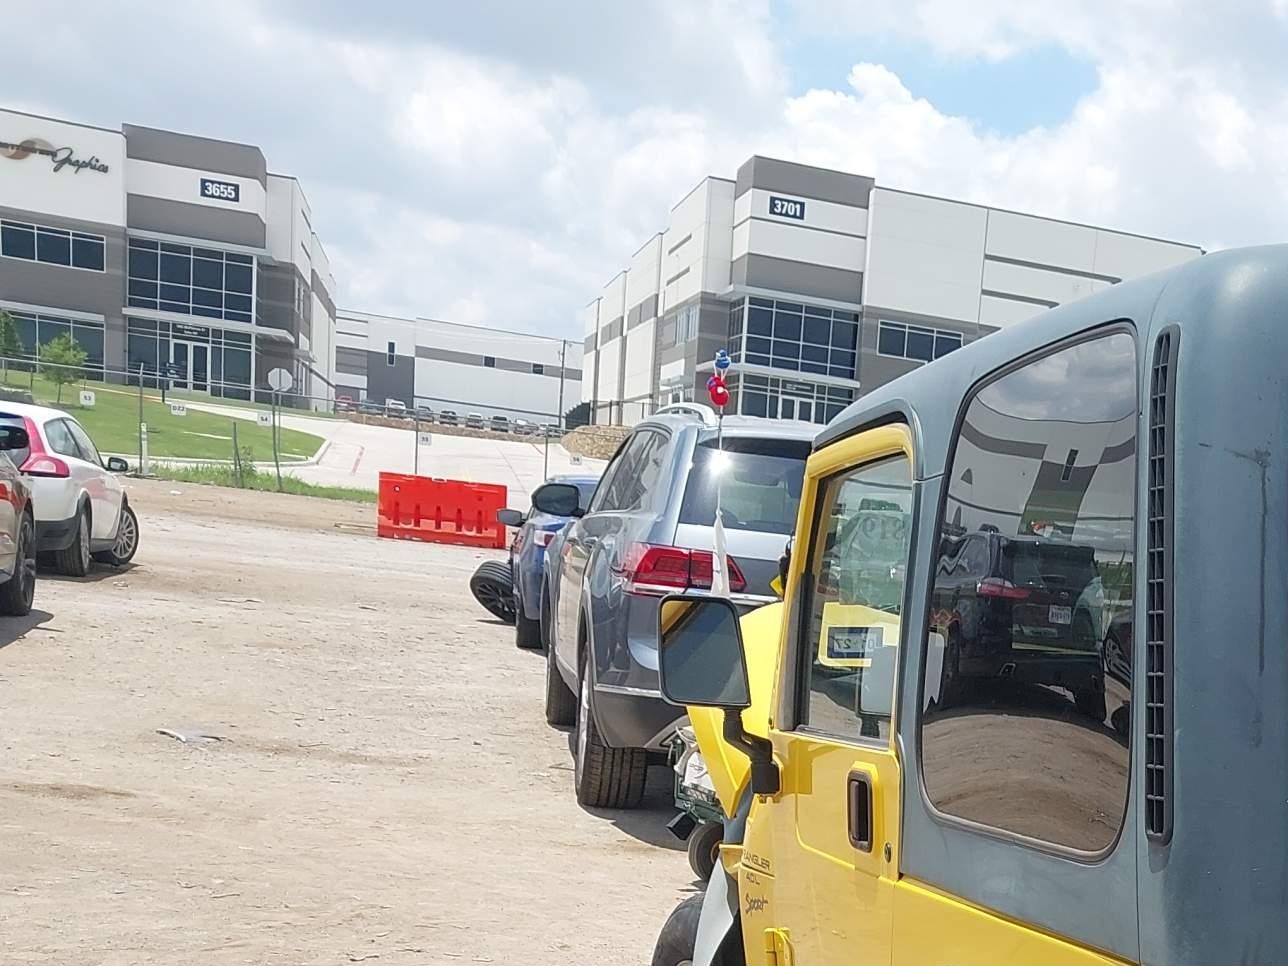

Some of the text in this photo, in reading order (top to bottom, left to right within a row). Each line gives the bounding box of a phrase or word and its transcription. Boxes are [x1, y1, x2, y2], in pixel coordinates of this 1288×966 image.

[51, 147, 109, 174] Graphics
[204, 182, 236, 199] 3655
[773, 200, 801, 217] 3701
